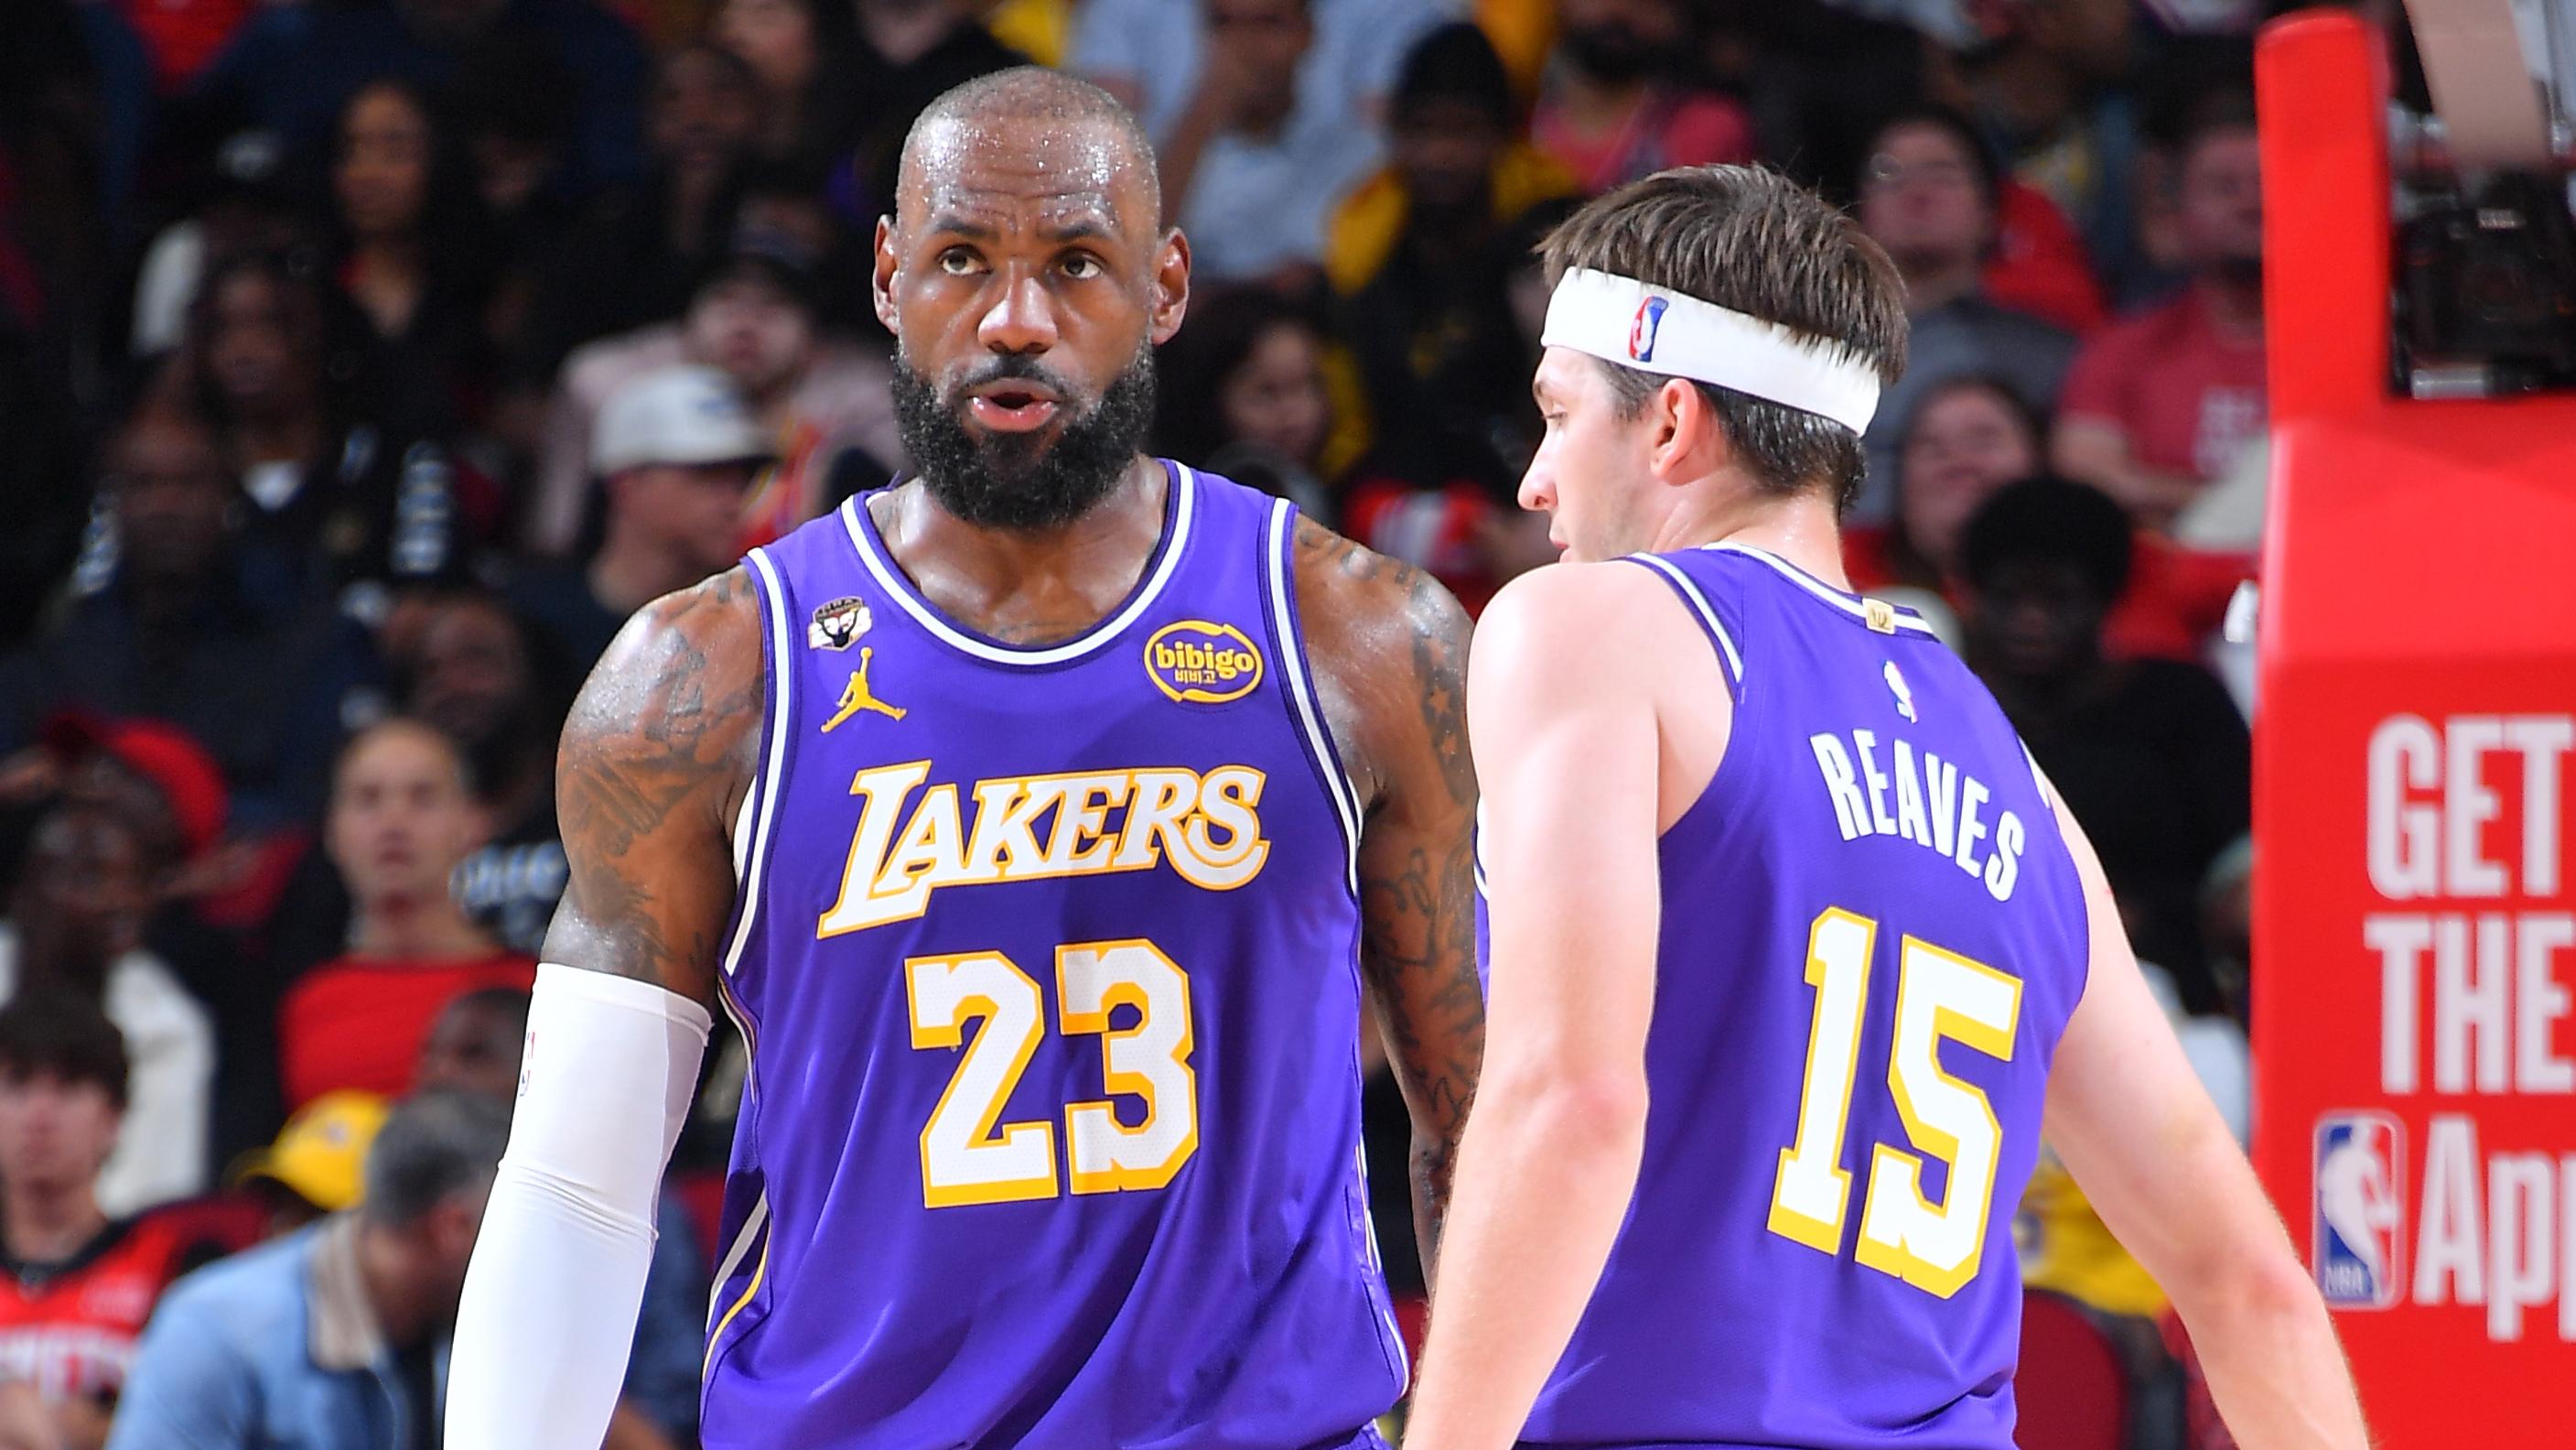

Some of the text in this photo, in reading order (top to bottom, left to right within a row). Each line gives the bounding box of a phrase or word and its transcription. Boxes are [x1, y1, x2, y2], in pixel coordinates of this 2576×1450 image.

[1155, 641, 1255, 679] bibigo
[816, 759, 1270, 939] LAKERS
[1809, 729, 2025, 903] REAVES
[2366, 714, 2576, 900] GET
[904, 939, 1199, 1208] 23
[2363, 913, 2576, 1095] THE
[1767, 906, 2023, 1299] 15
[2324, 1264, 2364, 1296] NBA
[2411, 1111, 2576, 1342] Ap
